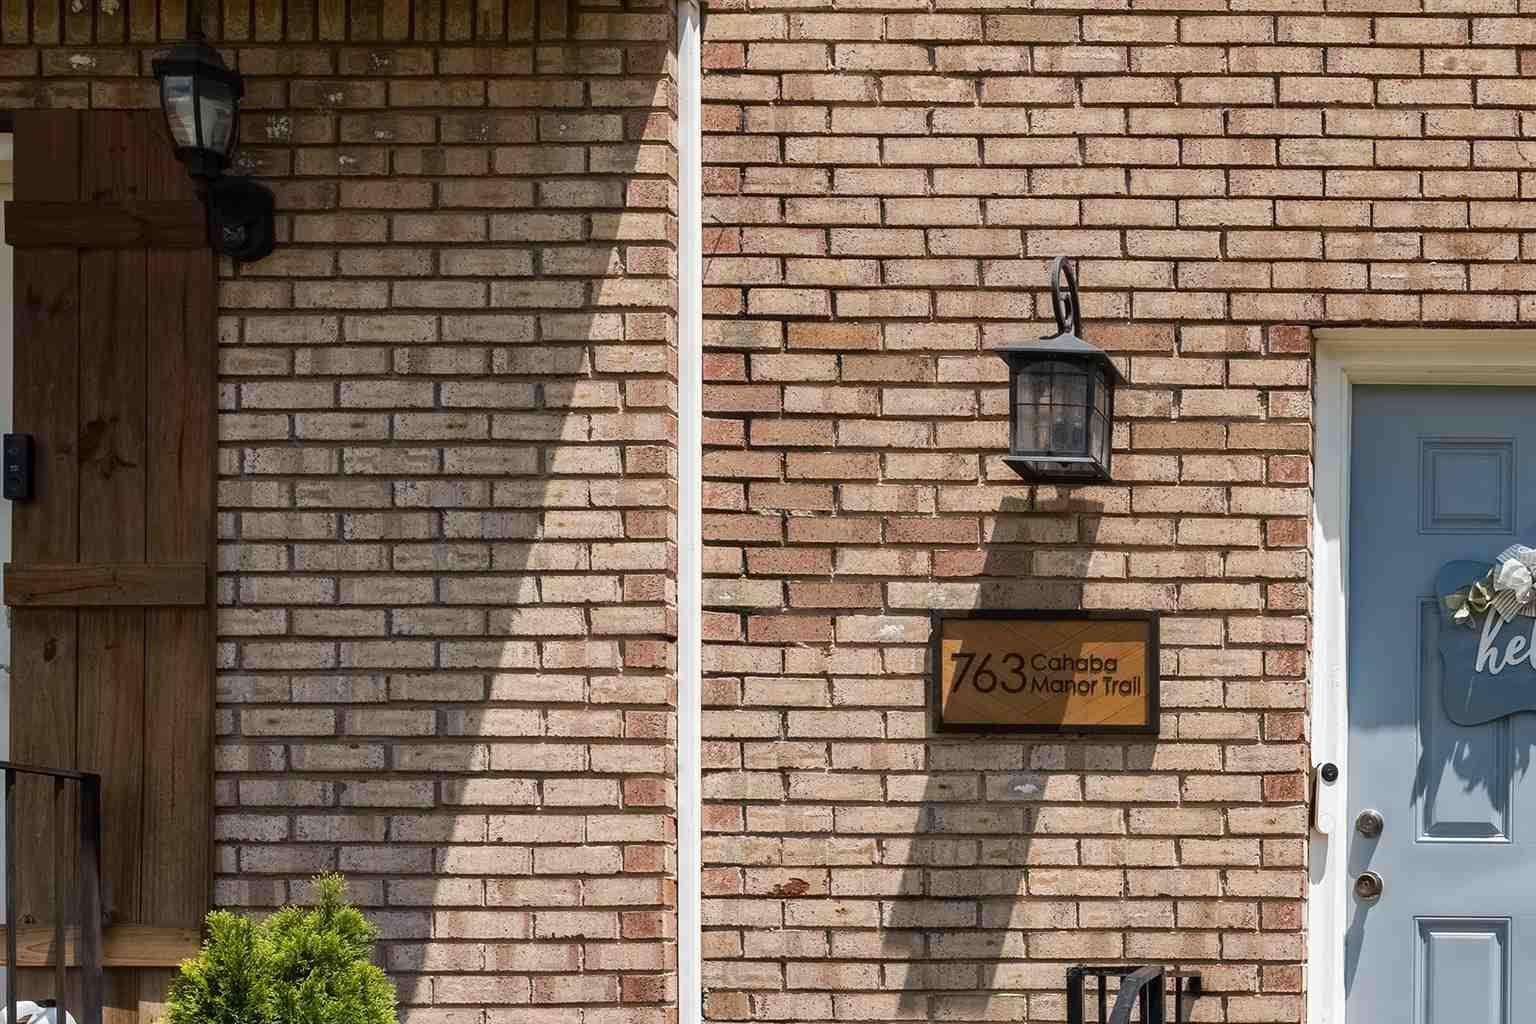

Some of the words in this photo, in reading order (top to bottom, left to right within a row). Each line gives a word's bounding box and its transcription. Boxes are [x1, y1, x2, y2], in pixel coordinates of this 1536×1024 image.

[950, 652, 1028, 694] 763
[1030, 653, 1119, 674] Cahaba
[1030, 675, 1098, 695] Manor
[1102, 675, 1142, 697] Trail
